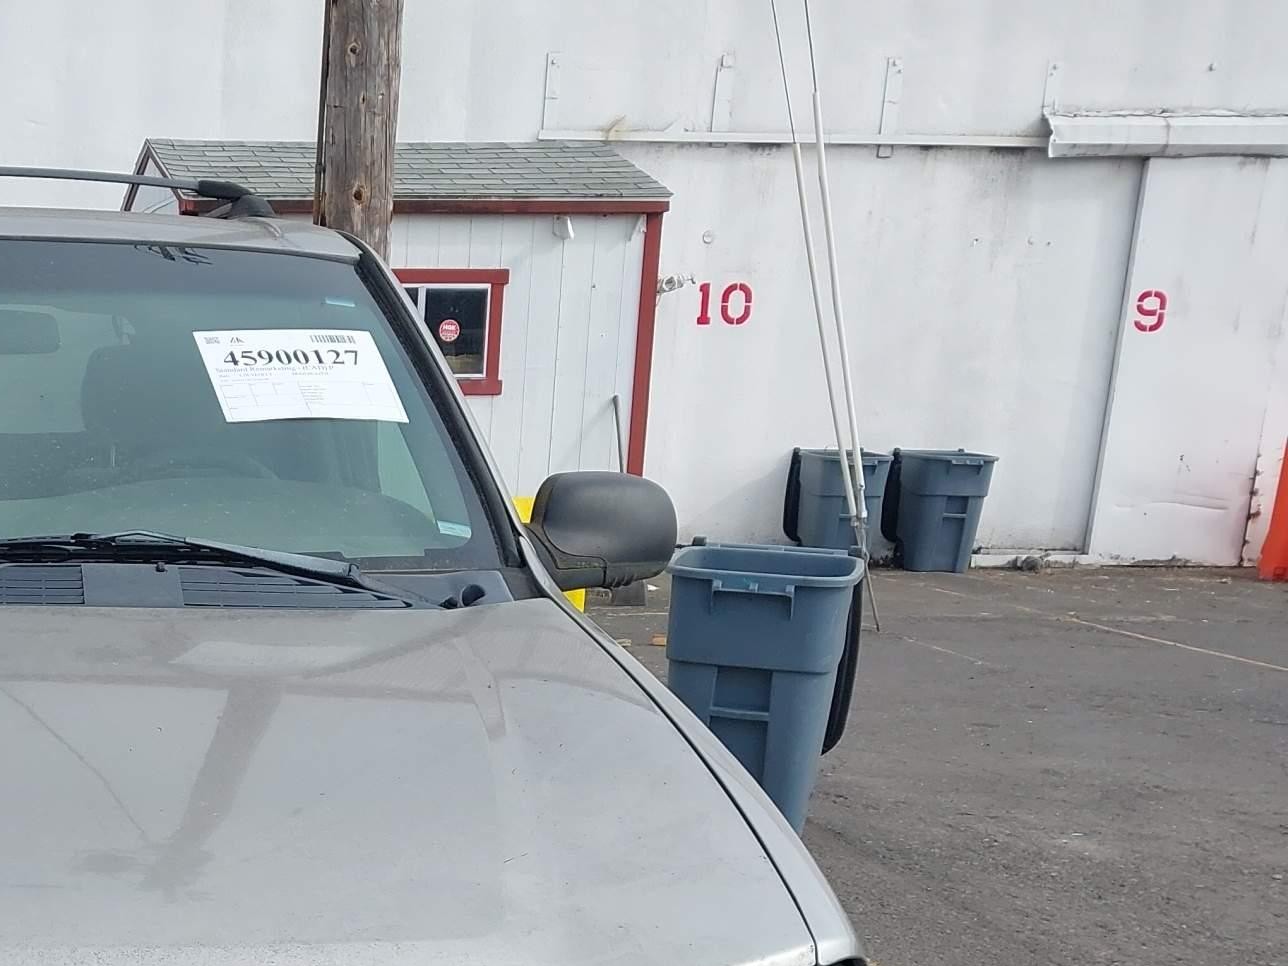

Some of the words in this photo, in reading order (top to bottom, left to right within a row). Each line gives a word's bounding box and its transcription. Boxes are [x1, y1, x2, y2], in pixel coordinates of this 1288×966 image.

[696, 282, 753, 325] 10
[1134, 290, 1167, 332] 9
[223, 350, 359, 366] 45900127
